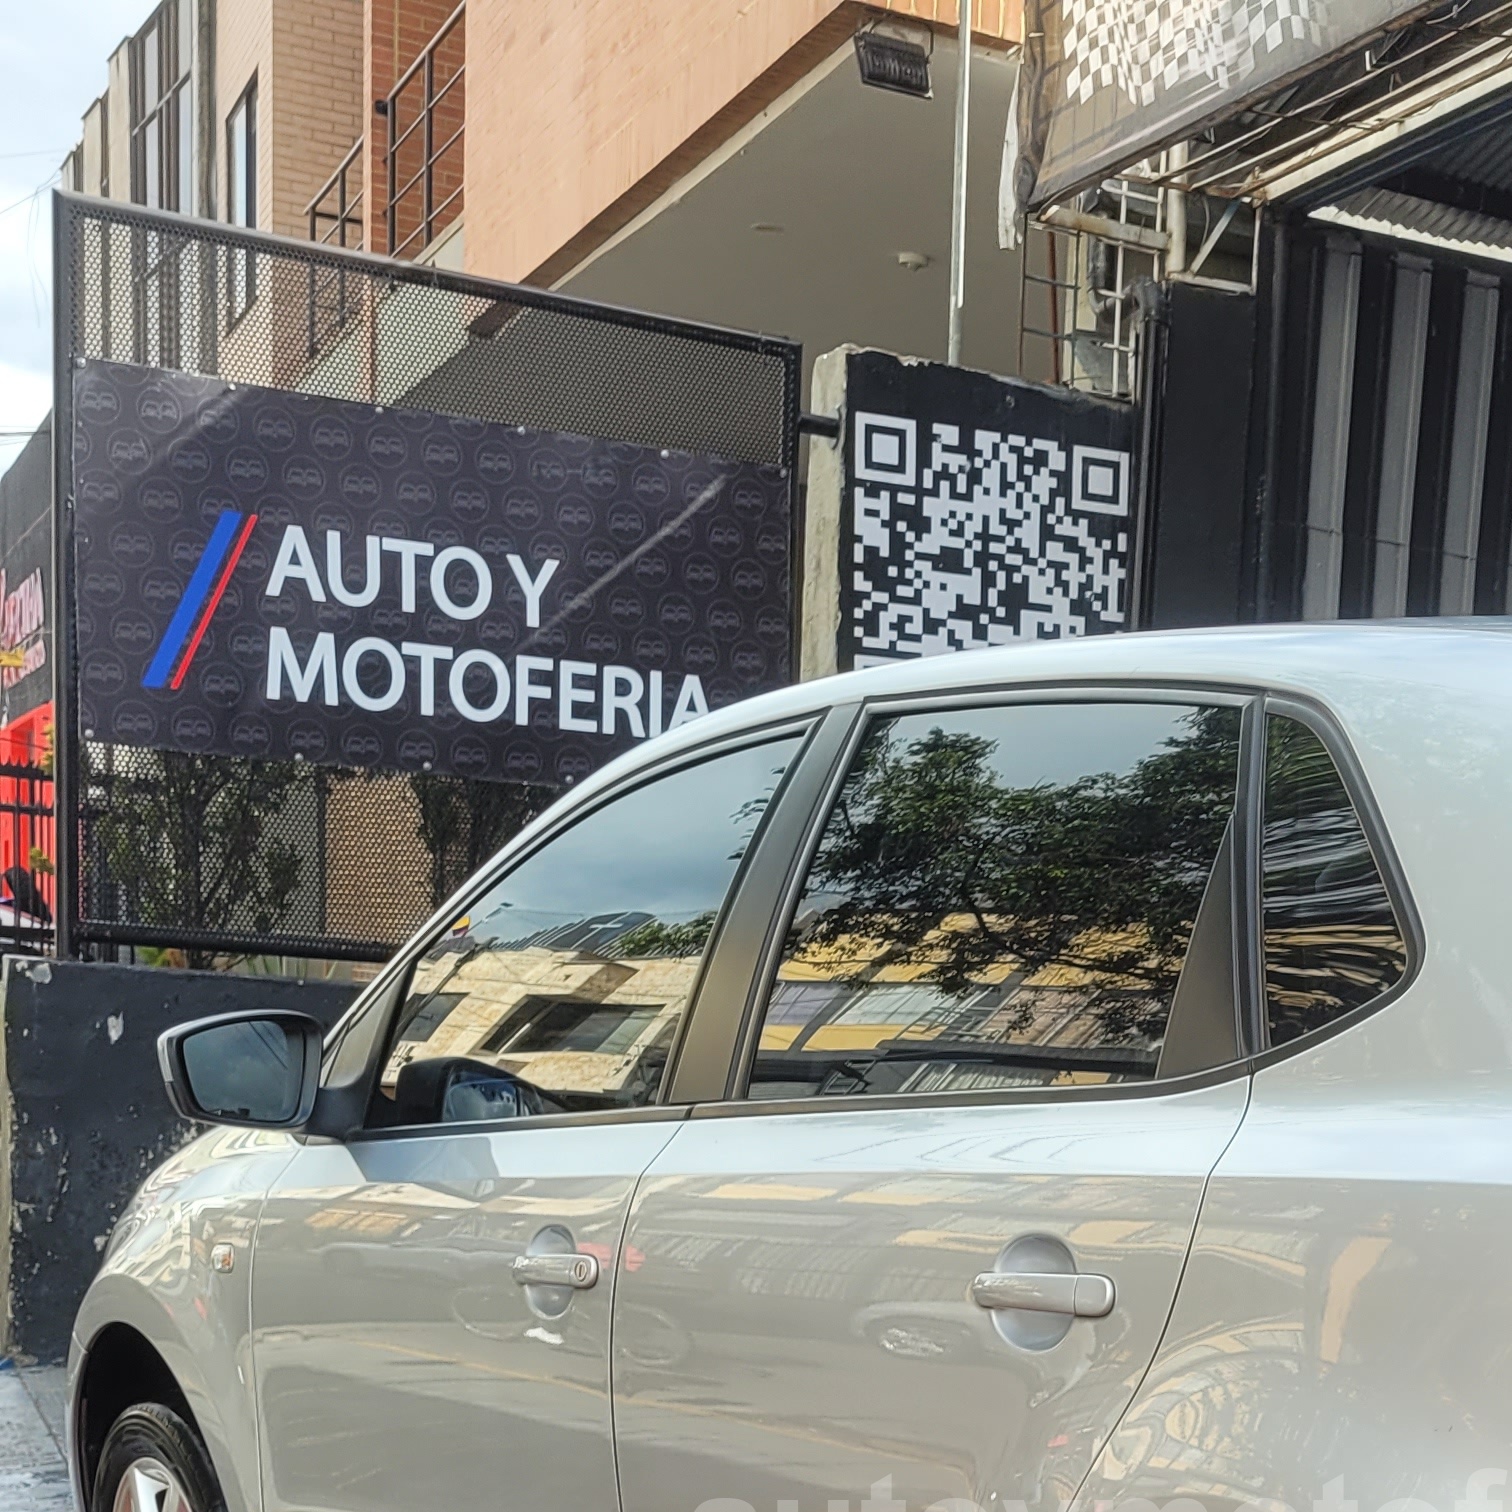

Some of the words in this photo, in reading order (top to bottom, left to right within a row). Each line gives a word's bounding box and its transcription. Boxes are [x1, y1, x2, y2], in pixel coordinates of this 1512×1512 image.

[264, 523, 493, 621] AUTO
[505, 553, 561, 629] Y
[265, 625, 711, 739] MOTOFERIA
